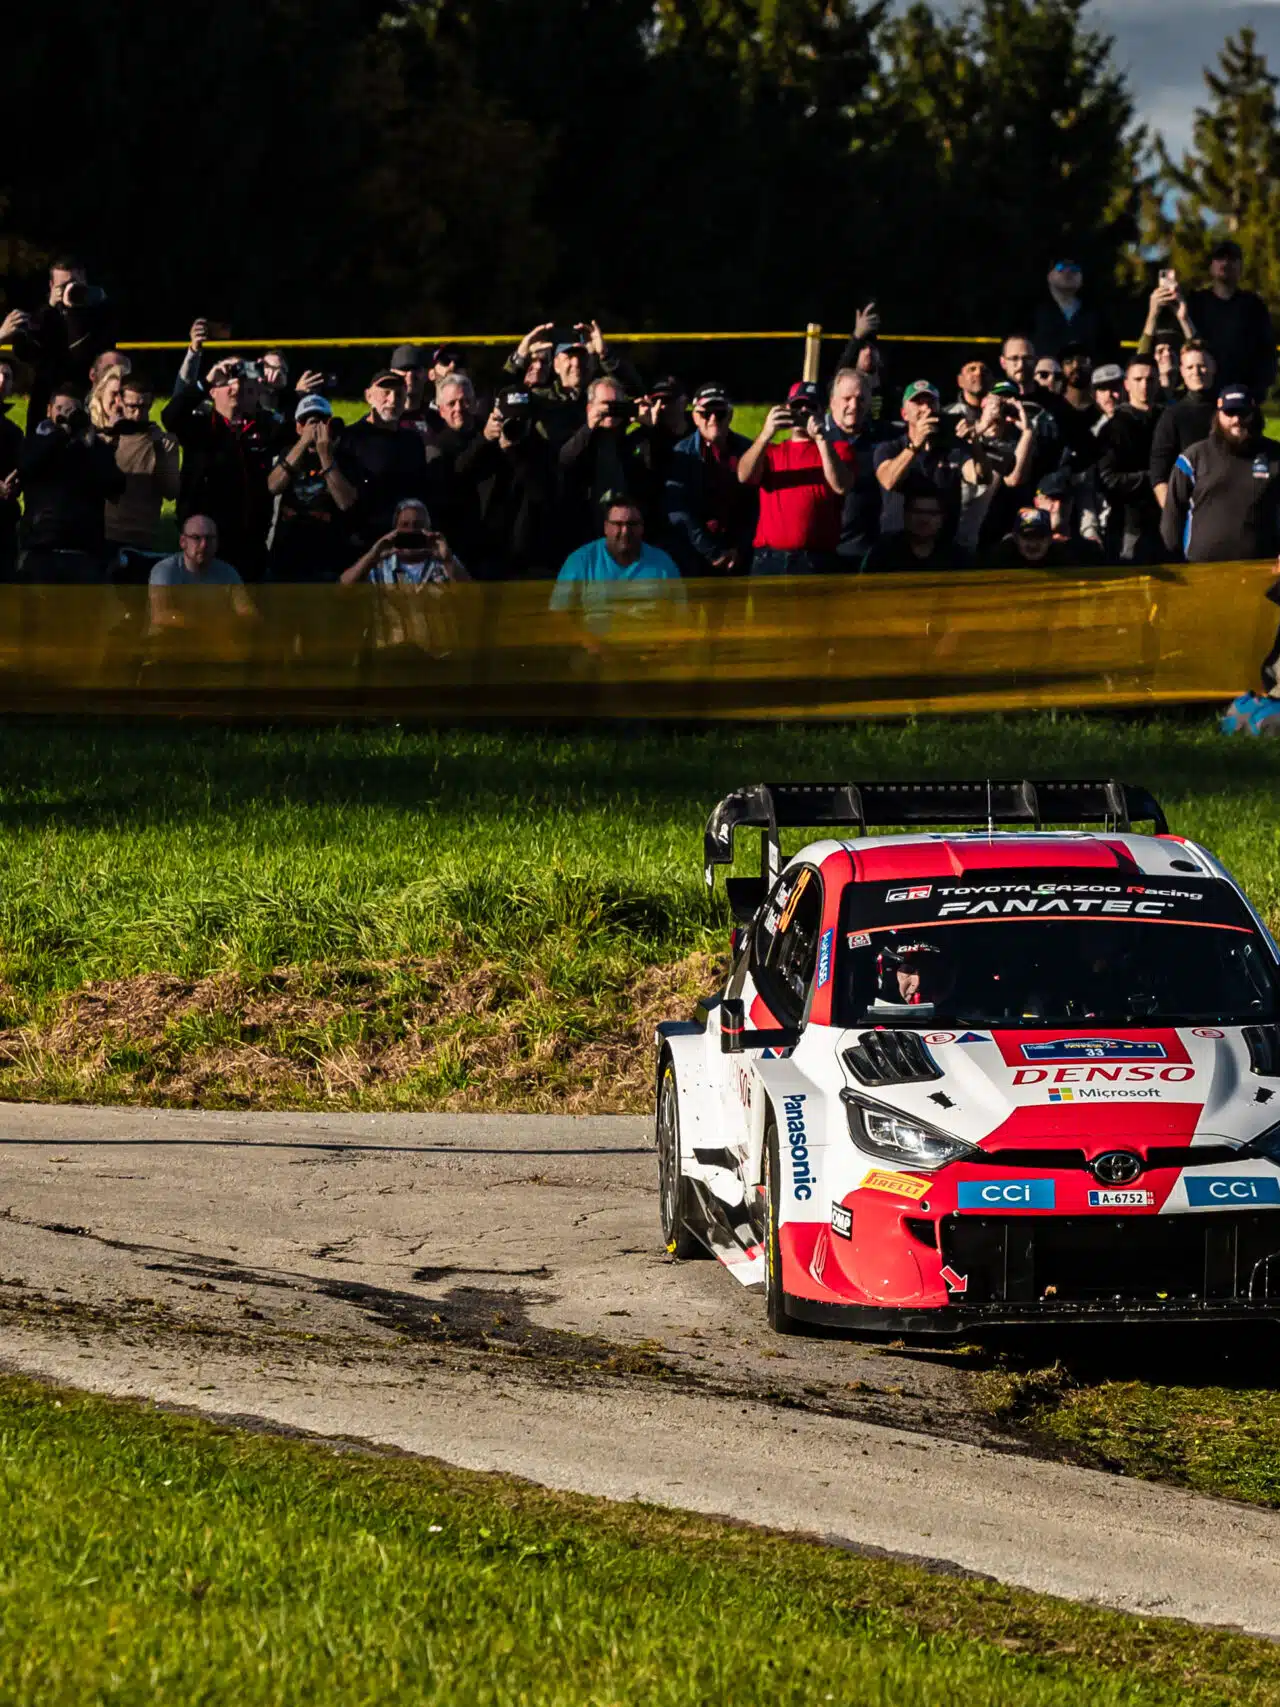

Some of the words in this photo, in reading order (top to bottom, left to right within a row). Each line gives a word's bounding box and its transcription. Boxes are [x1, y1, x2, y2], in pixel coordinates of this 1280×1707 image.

[887, 886, 931, 901] GR
[938, 885, 1031, 896] TOYOTA
[1037, 883, 1121, 893] GAZOO
[1126, 886, 1203, 900] Racing
[938, 899, 1170, 916] FANATEC
[1085, 1048, 1105, 1057] 33
[1012, 1066, 1196, 1086] DENSO
[1078, 1087, 1162, 1098] Microsoft
[783, 1094, 817, 1201] Panasonic
[866, 1172, 925, 1196] PIRELLI
[1102, 1193, 1143, 1204] A-6752
